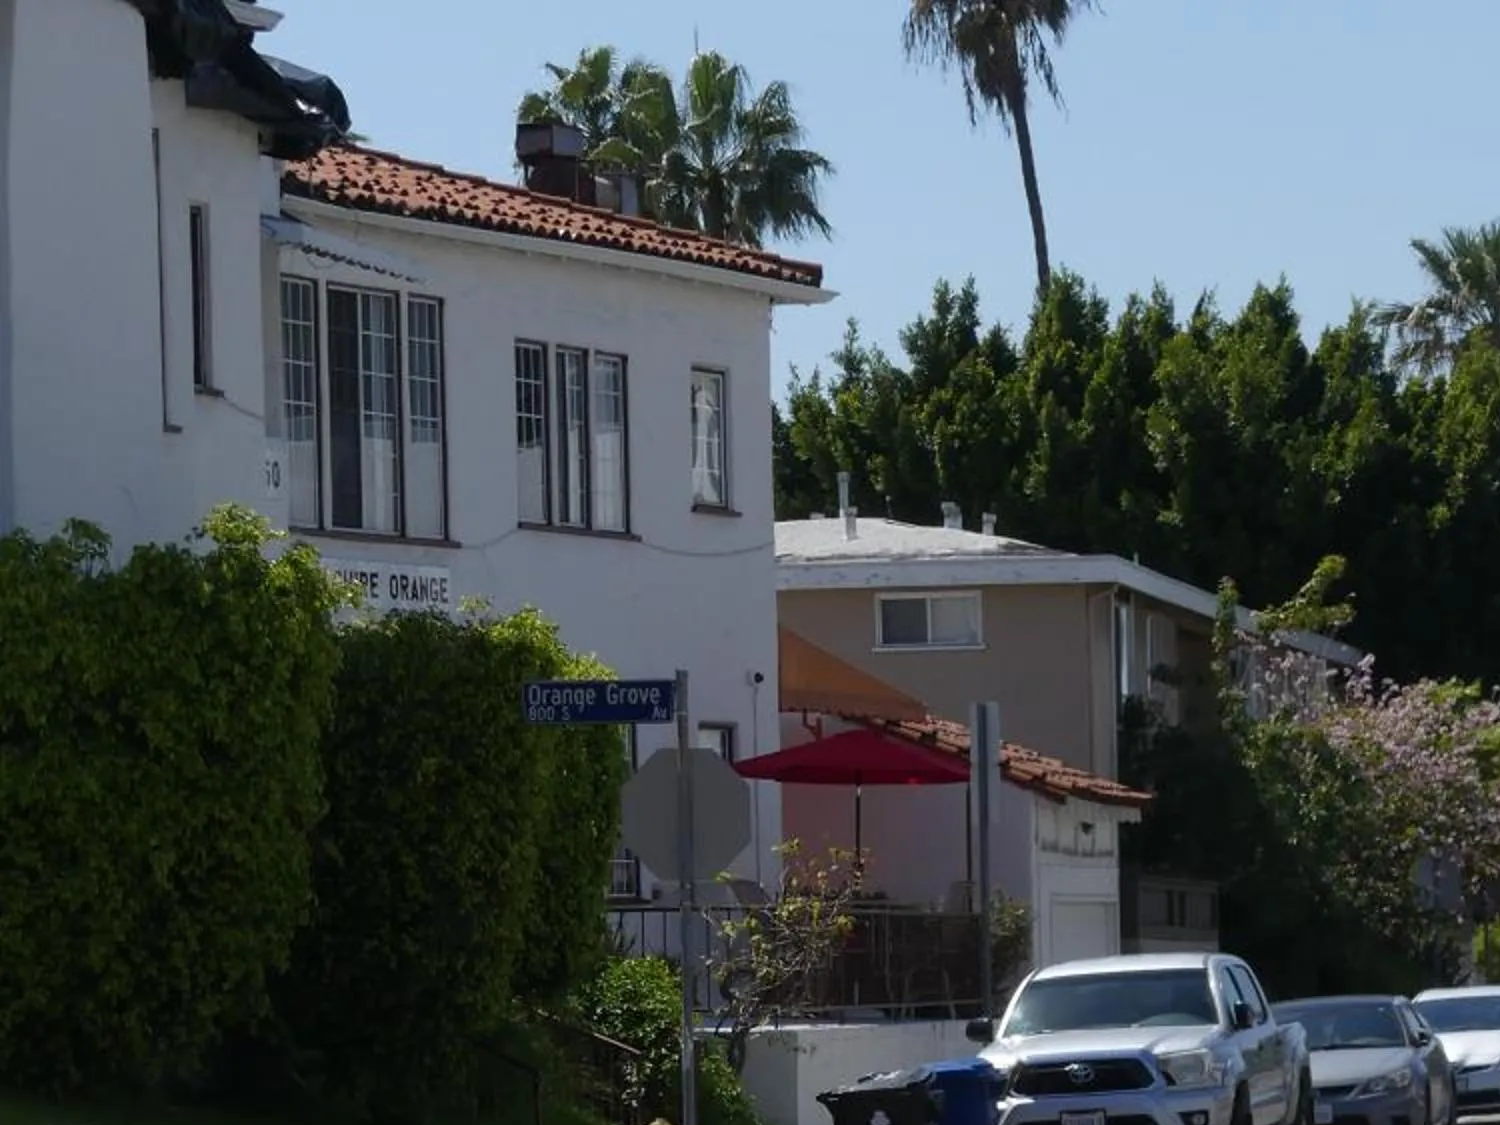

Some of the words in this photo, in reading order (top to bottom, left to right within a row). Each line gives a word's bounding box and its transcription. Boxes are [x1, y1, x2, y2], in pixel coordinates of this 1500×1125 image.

[389, 574, 449, 603] ORANGE
[528, 684, 597, 713] Orange
[606, 683, 662, 705] Grove
[528, 706, 555, 721] 800
[561, 706, 571, 721] S
